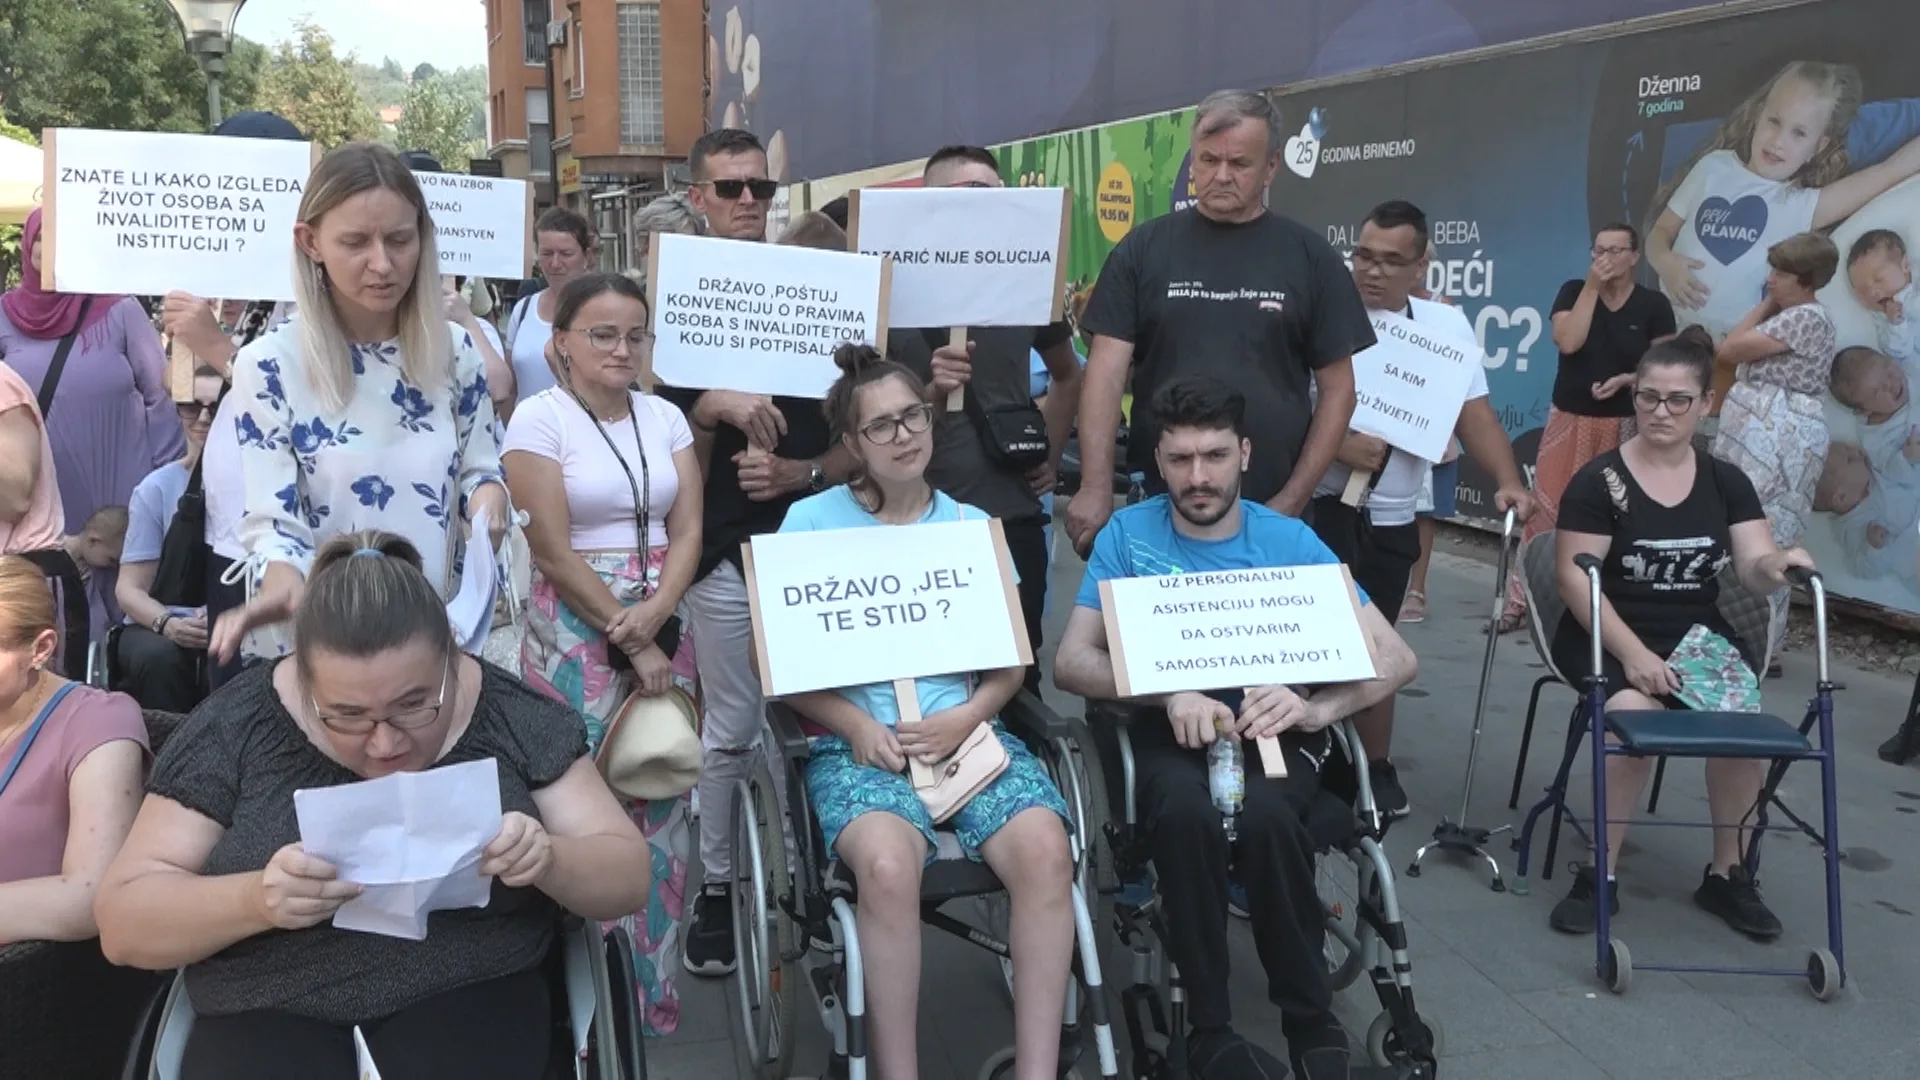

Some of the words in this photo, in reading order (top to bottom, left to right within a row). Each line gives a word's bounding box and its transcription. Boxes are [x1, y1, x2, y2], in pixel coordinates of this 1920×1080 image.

[1639, 74, 1701, 98] Dženna
[1638, 102, 1644, 116] 7
[1646, 98, 1684, 118] godina
[1296, 141, 1313, 164] 25
[1321, 145, 1361, 164] GODINA
[1363, 139, 1415, 160] BRINEMO
[61, 168, 125, 185] ZNATE
[132, 171, 148, 186] LI
[155, 172, 211, 189] KAKO
[217, 176, 303, 193] IZGLEDA
[441, 177, 458, 188] NA
[460, 179, 493, 190] IZBOR
[98, 188, 155, 206] ŽIVOT
[162, 193, 232, 211] OSOBA
[239, 197, 265, 212] SA
[429, 201, 462, 213] ZNAČI
[97, 212, 246, 232] INVALIDITETOM
[254, 219, 266, 232] U
[1328, 225, 1347, 246] DA
[1435, 220, 1480, 244] BEBA
[1701, 223, 1758, 243] PLAVAC
[117, 233, 228, 252] INSTITUCIJI
[236, 238, 245, 252] ?
[935, 250, 969, 264] NIJE
[974, 249, 1051, 264] SOLUCIJA
[699, 277, 766, 296] DRŽAVO
[667, 293, 773, 315] KONVENCIJU
[779, 304, 790, 316] O
[796, 306, 866, 324] PRAVIMA
[665, 312, 724, 329] OSOBA
[729, 317, 739, 330] S
[744, 319, 866, 341] INVALIDITETOM
[680, 331, 725, 348] KOJU
[730, 336, 745, 349] SI
[1409, 334, 1464, 363] ODLUČITI
[1383, 363, 1398, 377] SA
[1401, 370, 1426, 388] KIM
[1372, 397, 1413, 425] ŽIVJETI
[783, 575, 901, 606] DRŽAVO
[1159, 577, 1181, 589] UZ
[1185, 570, 1295, 588] PERSONALNU
[817, 609, 855, 632] TE
[864, 602, 927, 627] STID
[936, 599, 951, 619] ?
[1153, 598, 1255, 615] ASISTENCIJU
[1260, 595, 1315, 609] MOGU
[1181, 628, 1206, 640] DA
[1211, 622, 1301, 639] OSTVARIM
[1155, 653, 1275, 672] SAMOSTALAN
[1280, 649, 1330, 664] ŽIVOT
[1336, 648, 1342, 661] !
